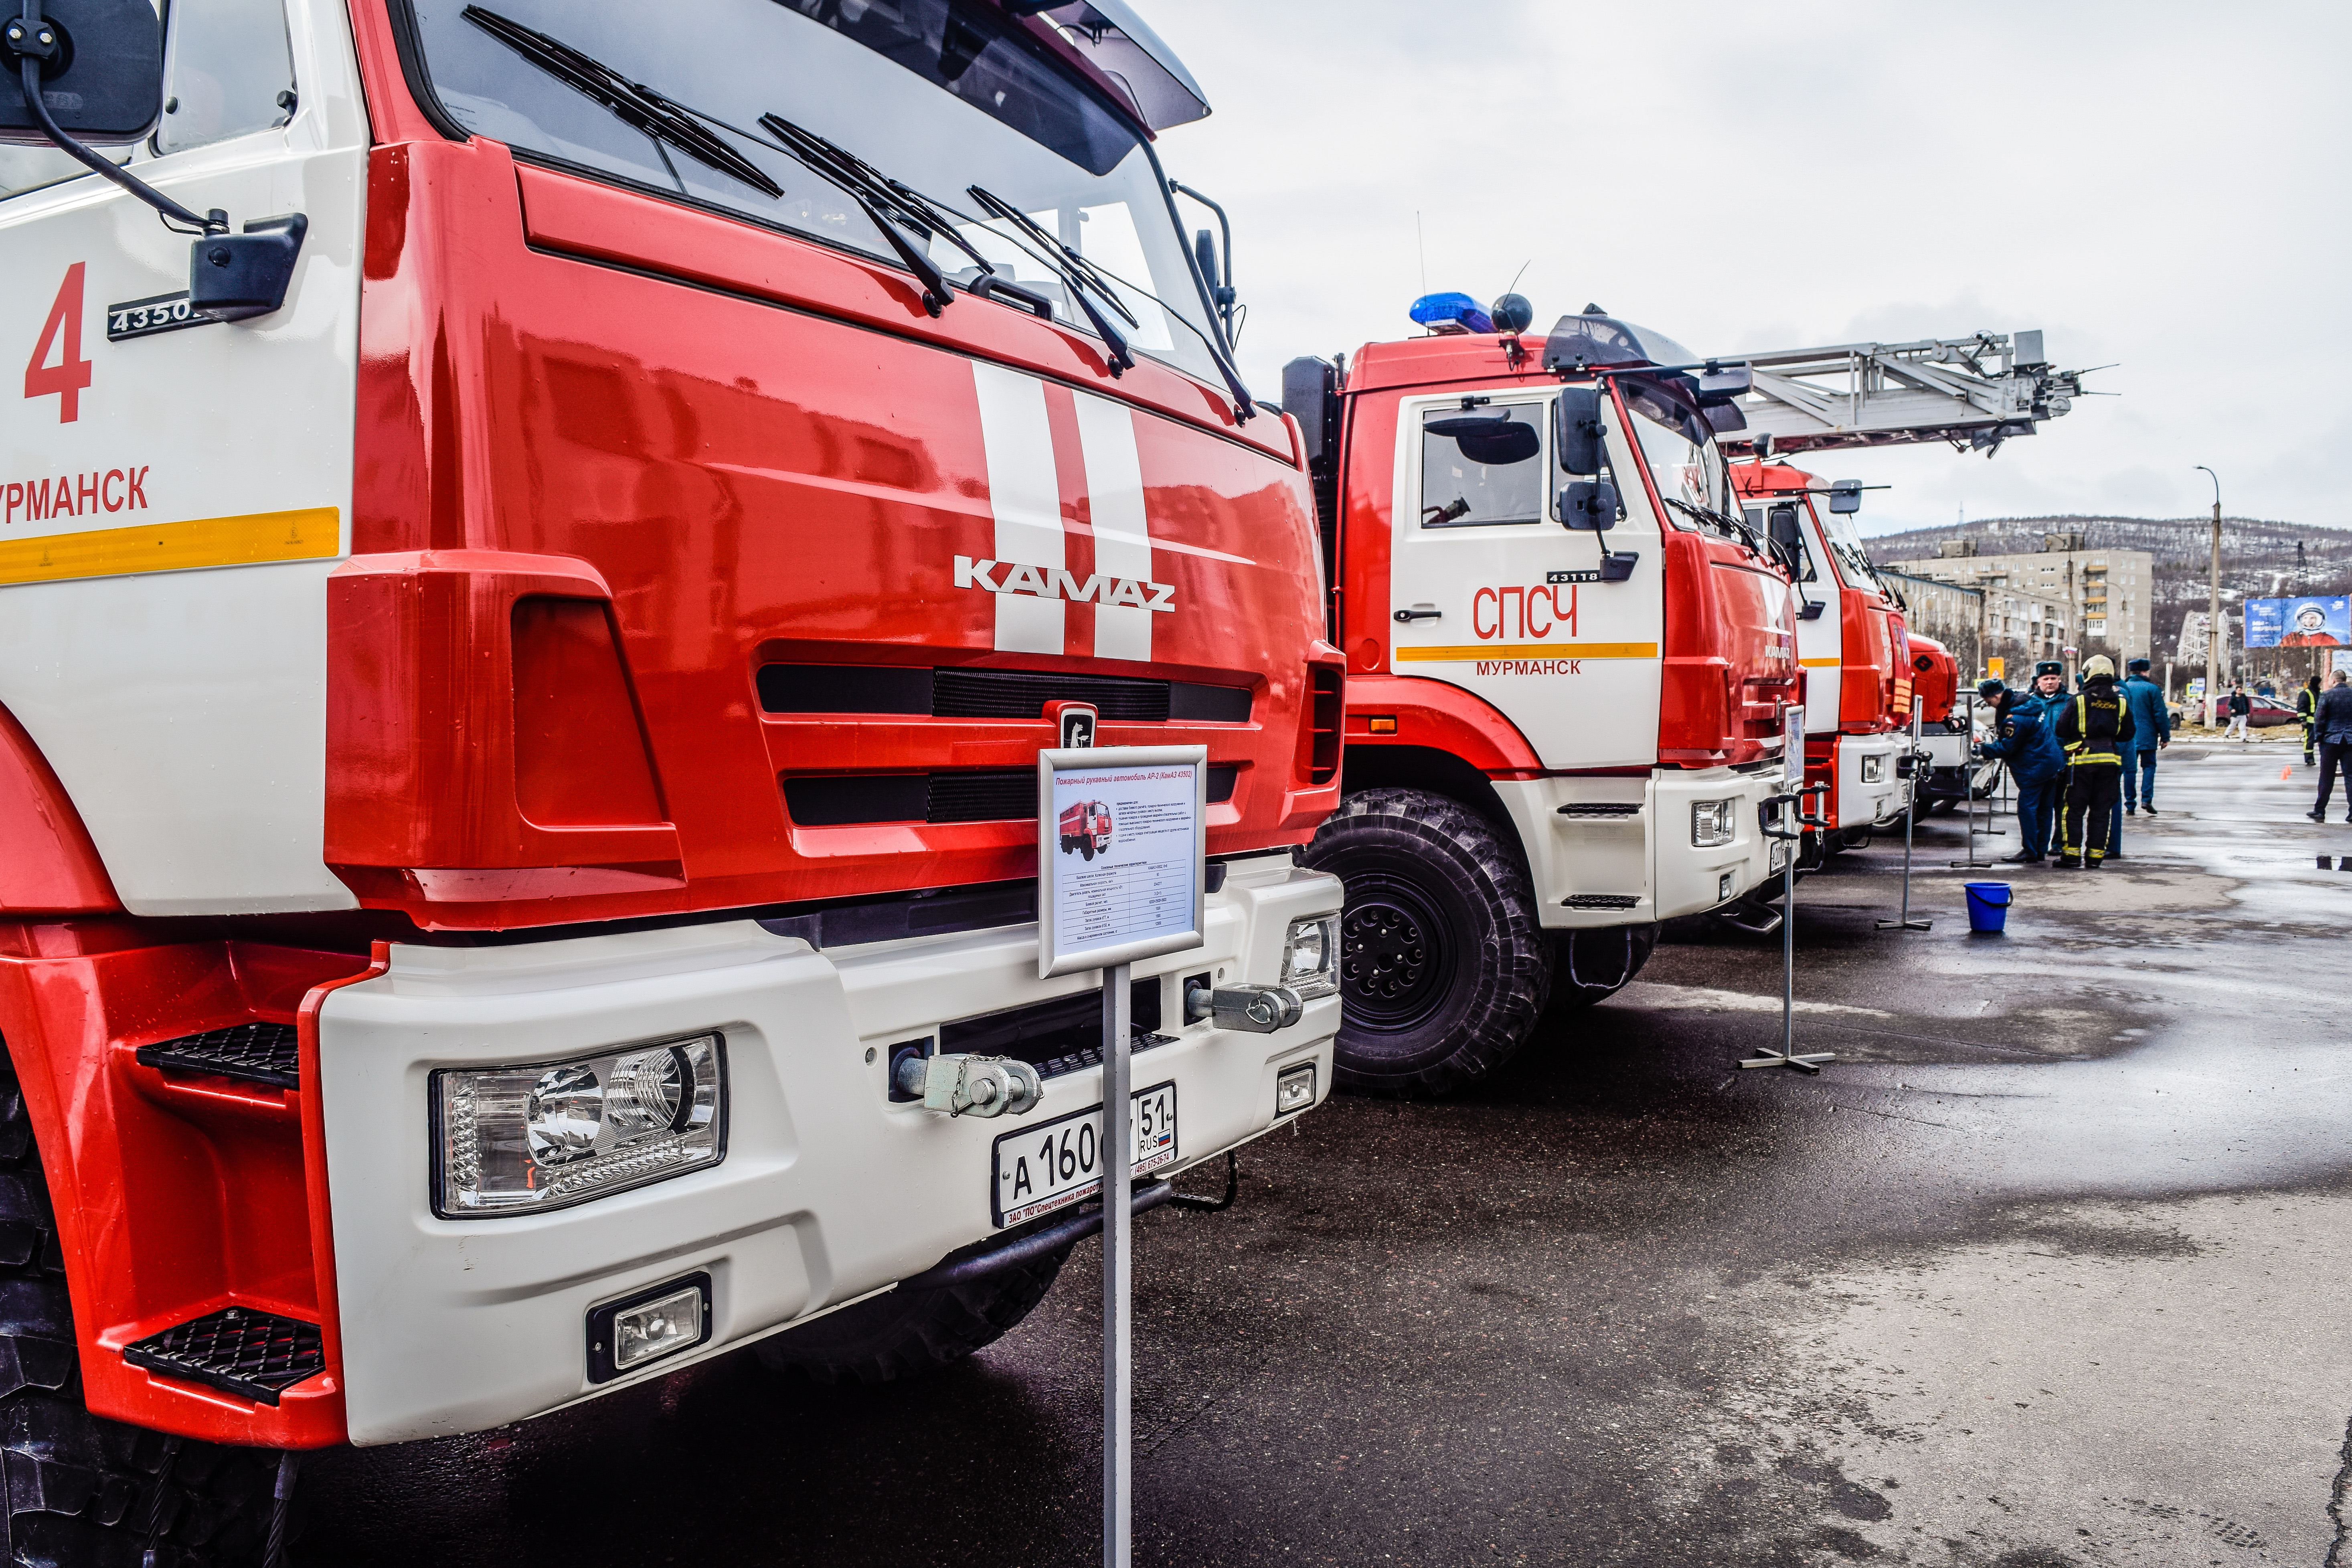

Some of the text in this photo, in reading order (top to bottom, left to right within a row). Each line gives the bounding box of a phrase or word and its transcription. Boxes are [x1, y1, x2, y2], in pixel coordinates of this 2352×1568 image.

[113, 301, 201, 331] 4350
[24, 261, 92, 423] 4
[0, 466, 149, 524] РМАНСК
[954, 554, 1175, 612] KAMAZ
[1549, 573, 1598, 582] 43118
[1474, 585, 1577, 639] СПСЧ
[1476, 660, 1581, 676] МУРМАНСК
[1765, 645, 1790, 659] KAMAZ
[1056, 776, 1085, 786] Пожарный
[1086, 775, 1112, 785] рукавный
[1113, 773, 1146, 782] автомобиль
[1160, 771, 1177, 781] (КамАЗ
[1178, 771, 1192, 779] 43502)
[1142, 1094, 1165, 1136] 51
[1140, 1135, 1158, 1153] RUS
[1014, 1156, 1032, 1200] А
[1135, 1152, 1170, 1176] (495) 675-26-74
[1008, 1210, 1022, 1224] ЗАО
[1075, 1181, 1103, 1199] пожароту
